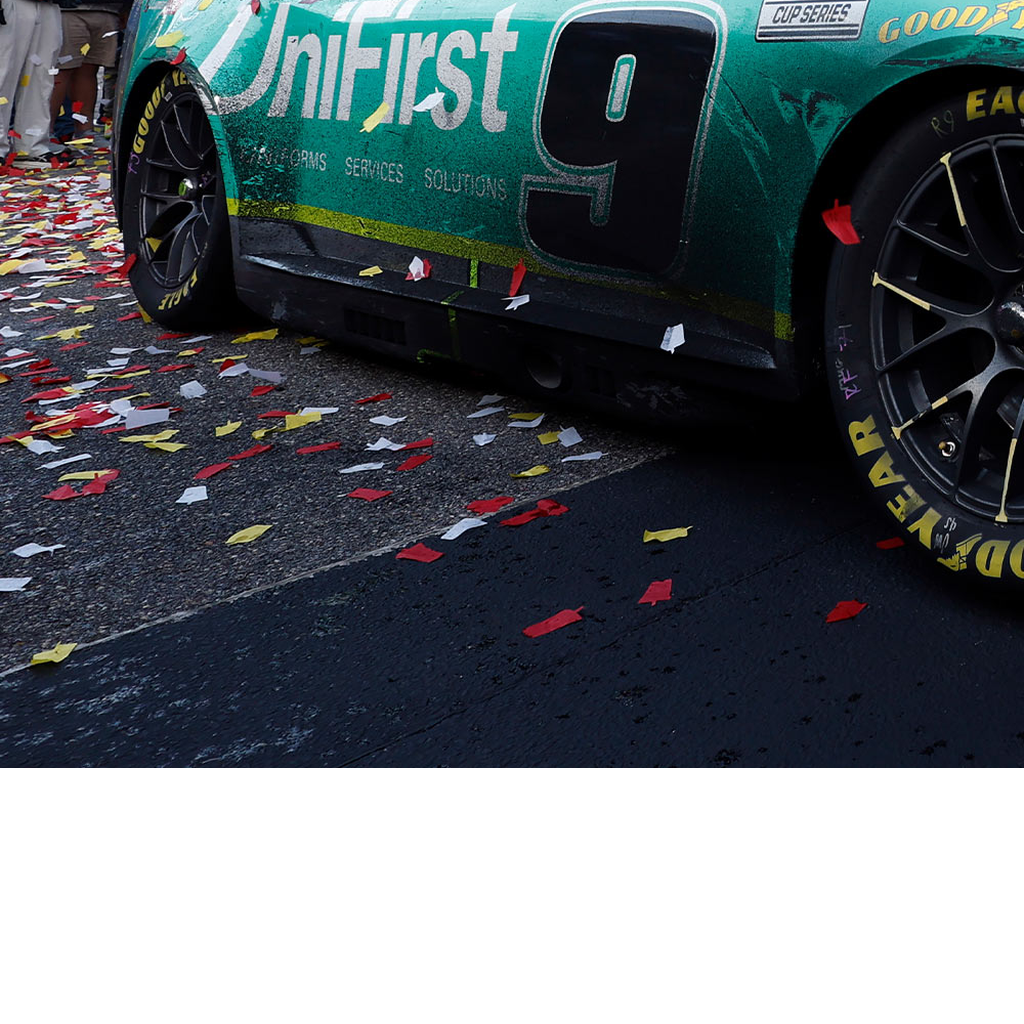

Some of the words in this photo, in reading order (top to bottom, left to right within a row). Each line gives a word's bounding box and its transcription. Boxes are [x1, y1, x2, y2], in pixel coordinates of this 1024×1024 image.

[771, 5, 802, 25] CUP
[800, 3, 852, 24] SERIES
[345, 156, 404, 183] SERVICES
[424, 168, 508, 201] SOLUTIONS
